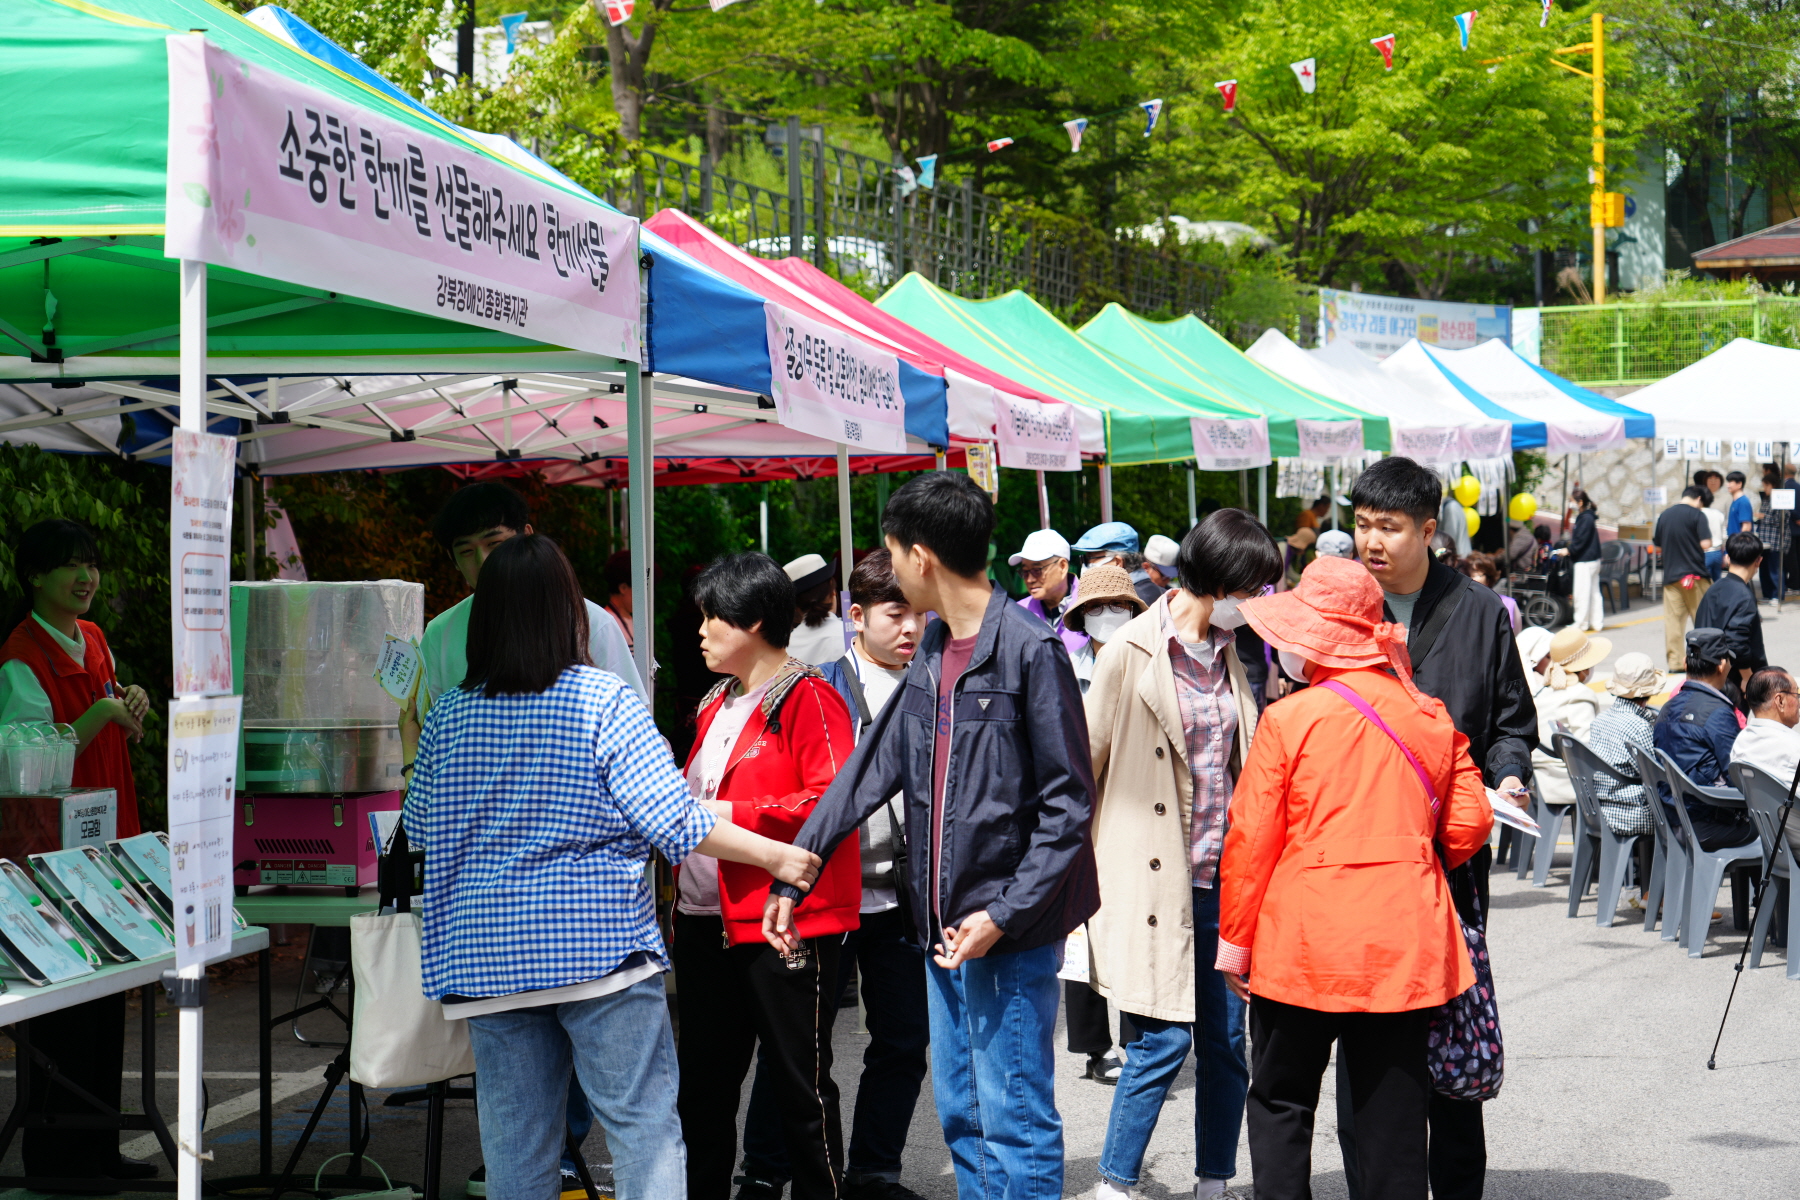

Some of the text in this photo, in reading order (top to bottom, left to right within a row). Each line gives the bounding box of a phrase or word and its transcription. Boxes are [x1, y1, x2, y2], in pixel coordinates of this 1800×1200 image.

[279, 107, 357, 210] 소중한
[359, 126, 432, 238] 한끼를
[434, 164, 540, 262] 선물해주세요
[436, 274, 528, 328] 강북장애인종합복지관
[80, 820, 101, 838] 모금함
[779, 949, 811, 959] CLLEGE
